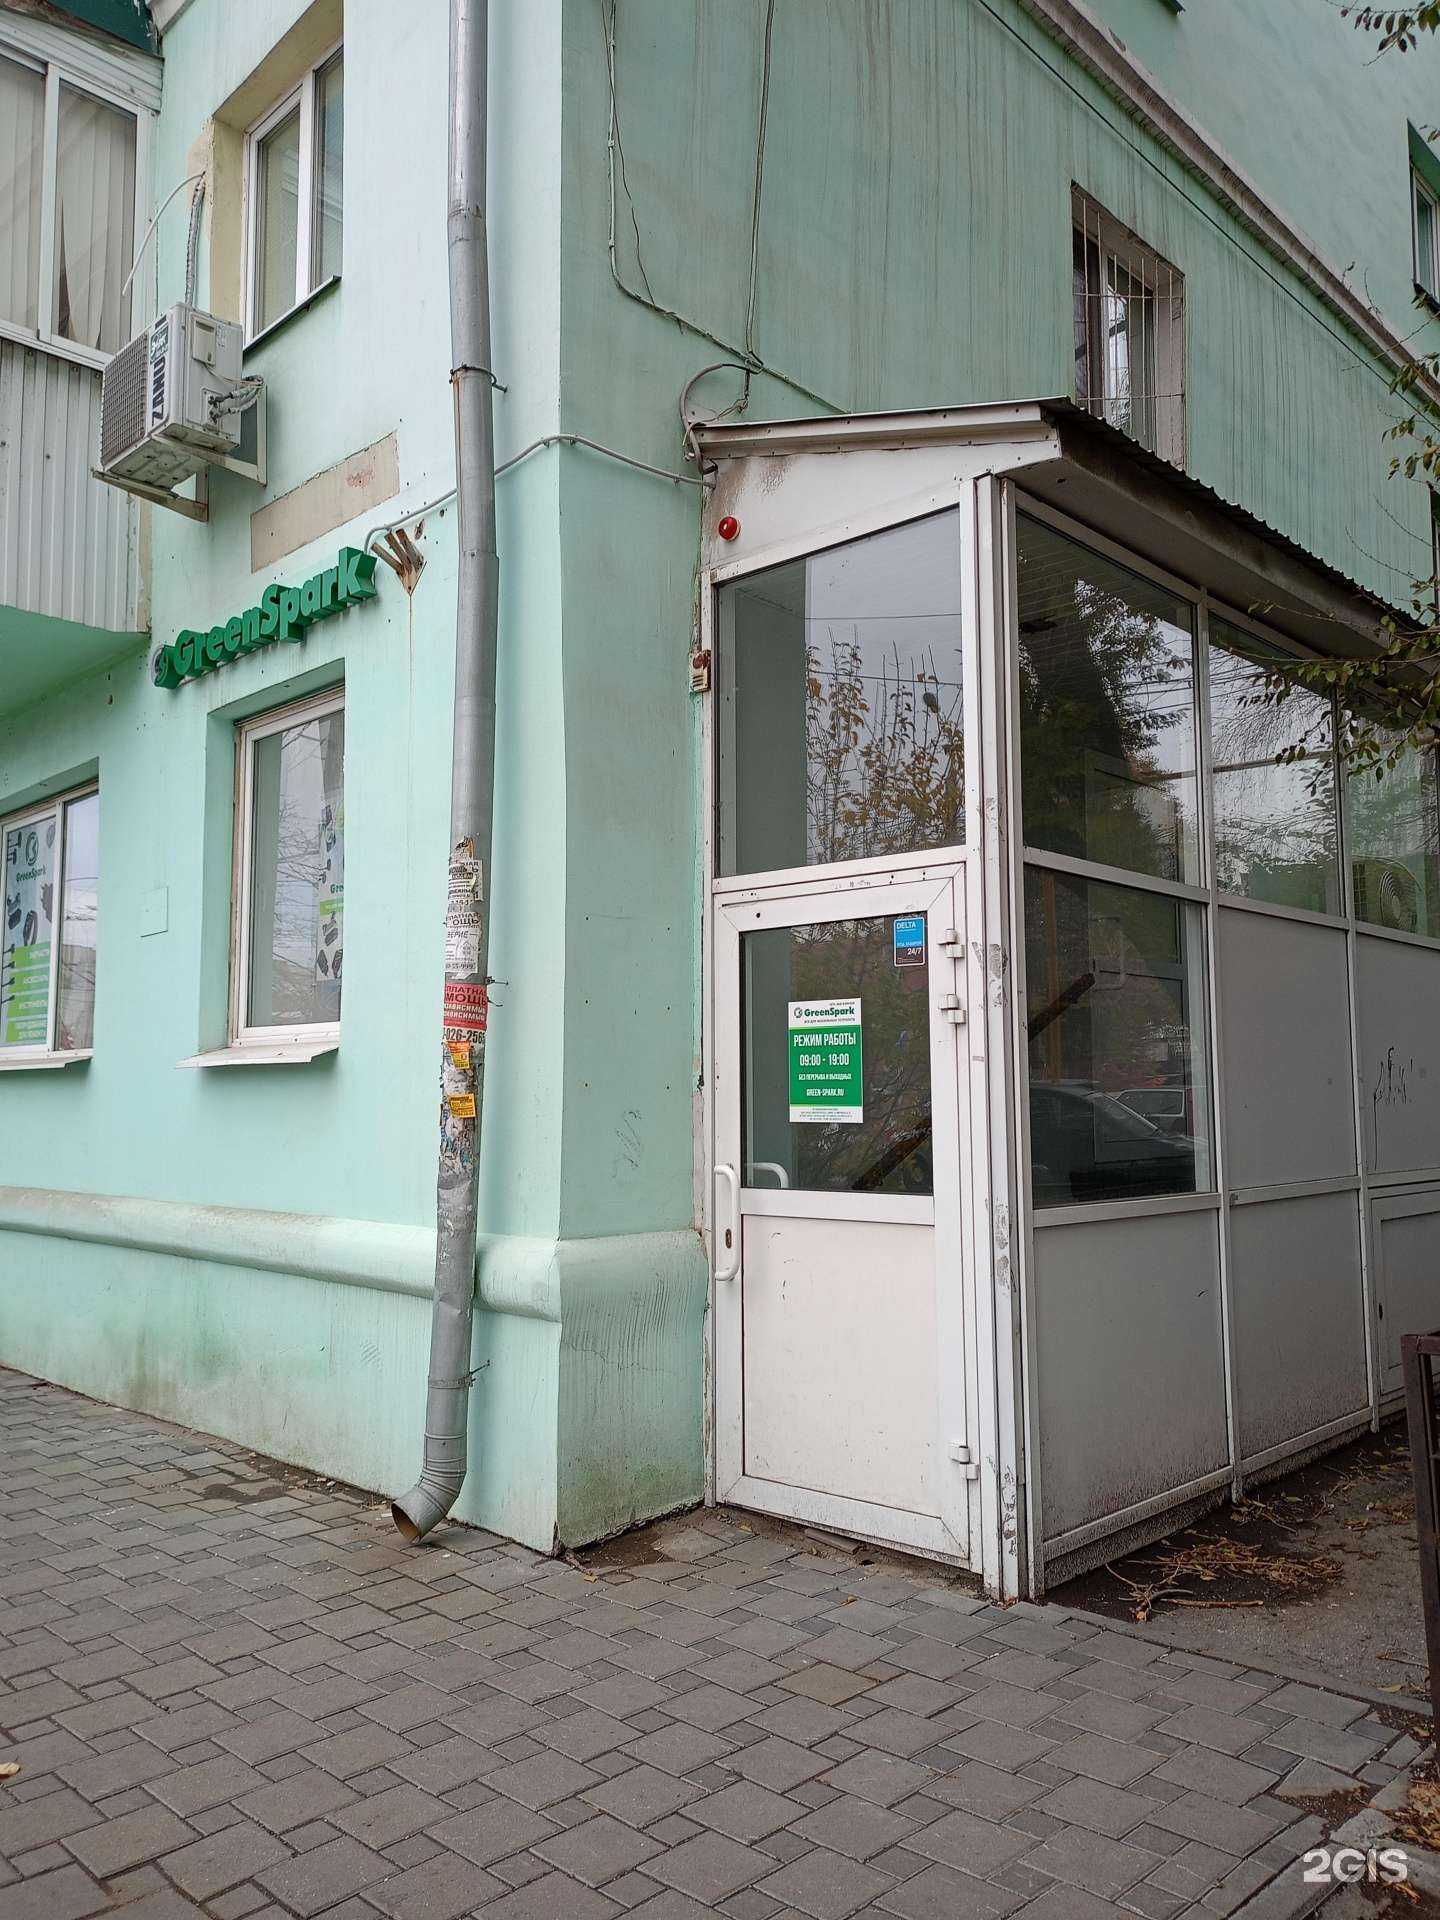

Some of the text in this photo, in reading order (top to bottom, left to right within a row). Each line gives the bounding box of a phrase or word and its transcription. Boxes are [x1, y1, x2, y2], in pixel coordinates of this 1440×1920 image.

[151, 316, 167, 427] ZANUI
[174, 546, 378, 676] GreenSpark
[16, 864, 47, 882] GreenSpark
[896, 921, 916, 929] DELTA
[907, 948, 922, 956] 24/7
[446, 986, 485, 995] ПЛАТНА
[804, 1006, 854, 1018] GreenSpark
[793, 1033, 856, 1047] РЕЖИМ РАБОТЫ
[799, 1054, 821, 1066] 09:00
[828, 1053, 850, 1066] 19:00
[806, 1088, 844, 1097] GREEN-SPARK.RU
